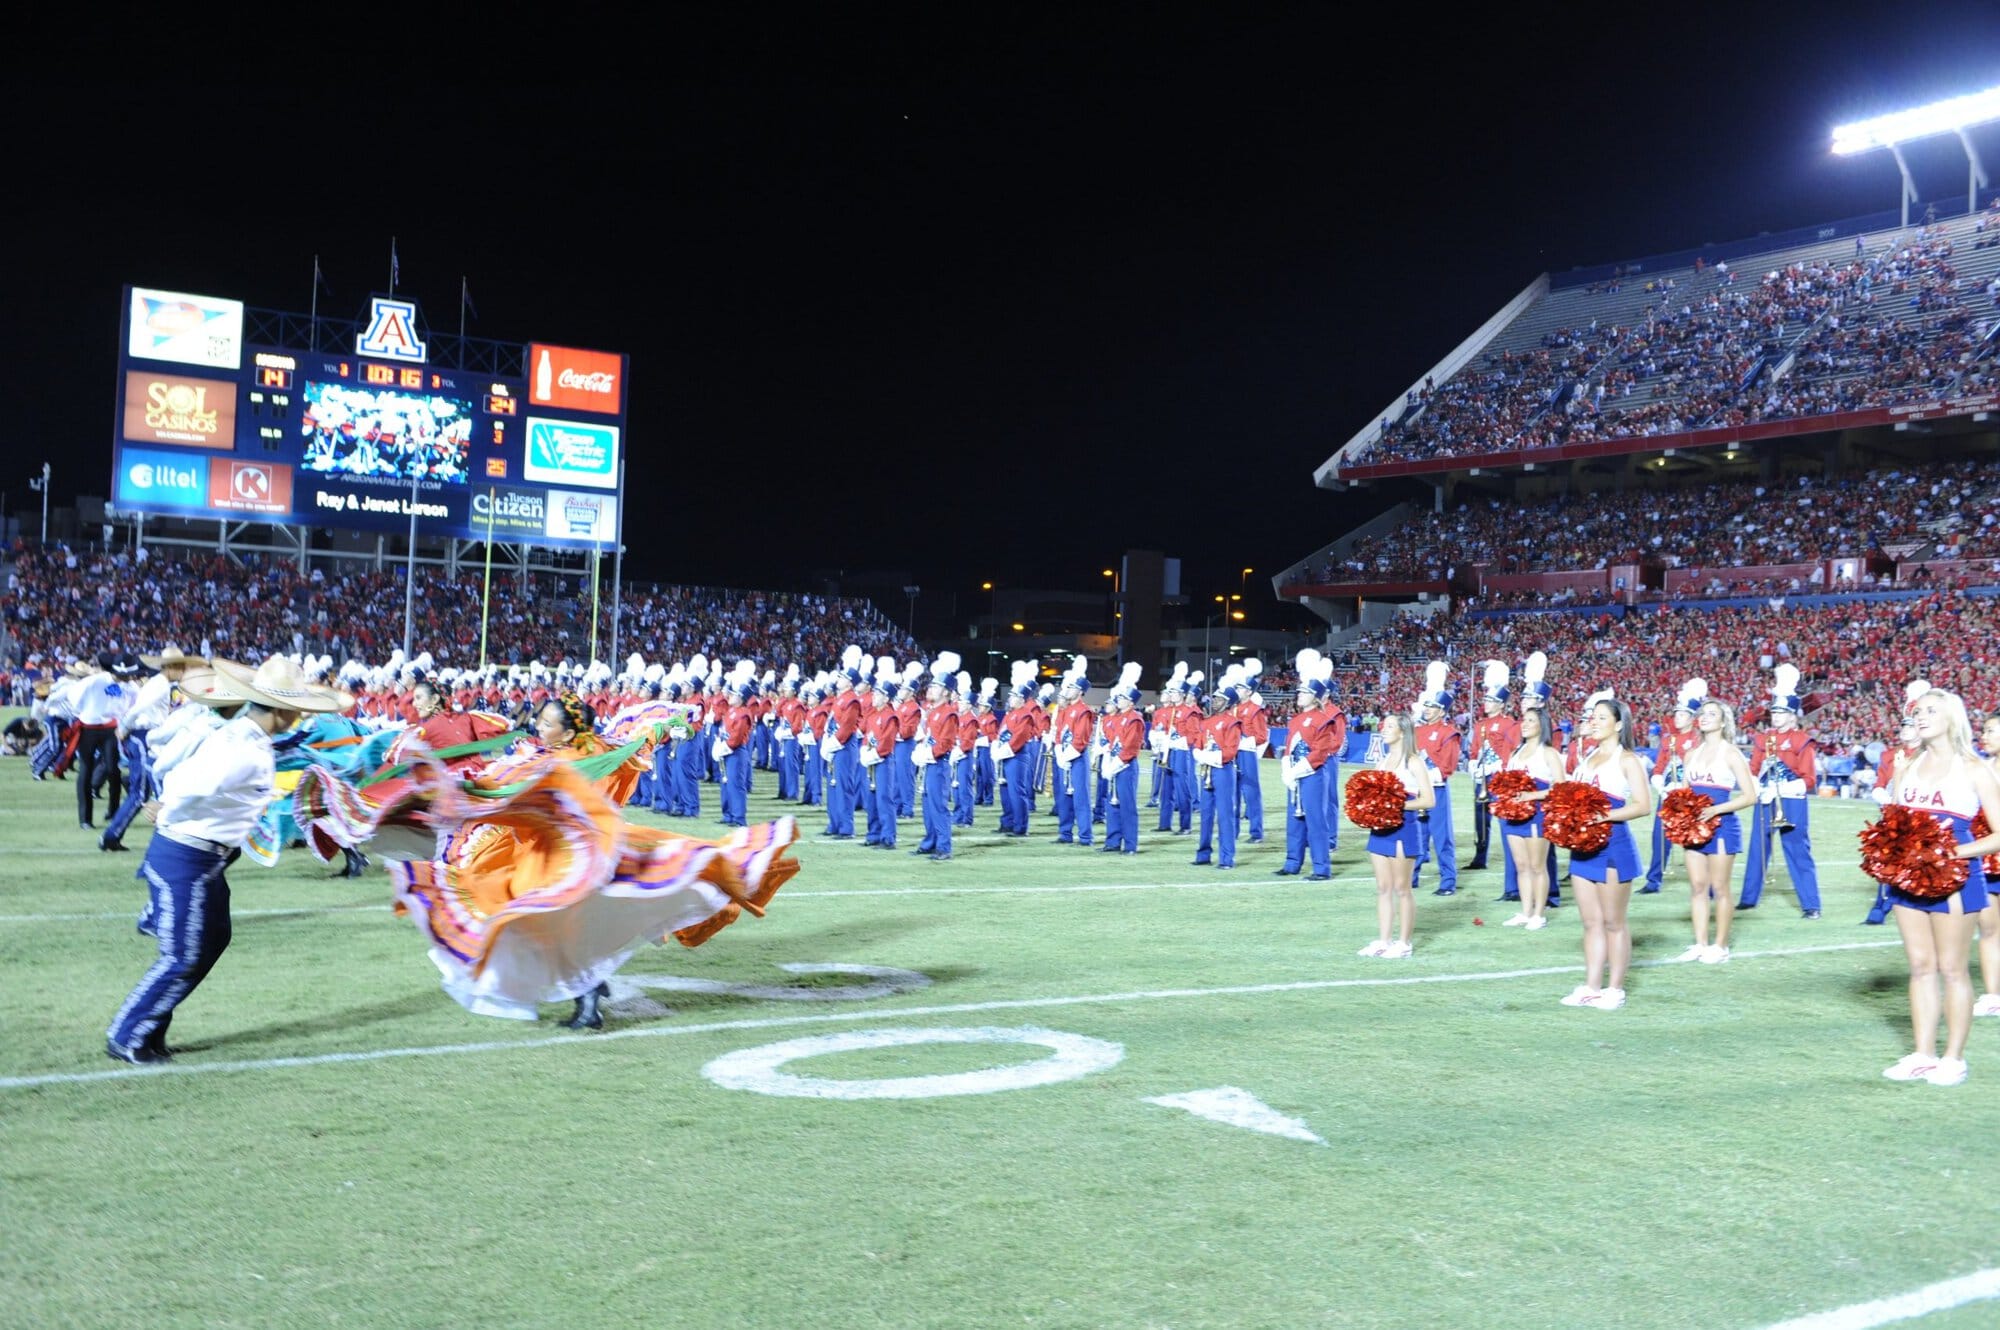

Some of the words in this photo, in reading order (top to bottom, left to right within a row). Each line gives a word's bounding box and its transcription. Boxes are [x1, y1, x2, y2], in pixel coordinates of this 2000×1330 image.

[356, 298, 426, 363] A
[146, 382, 217, 418] SOL
[145, 413, 217, 434] CASINOS
[316, 490, 345, 511] Ray
[473, 494, 544, 519] Ctizen
[507, 492, 543, 505] Tucson
[1931, 790, 1944, 807] A
